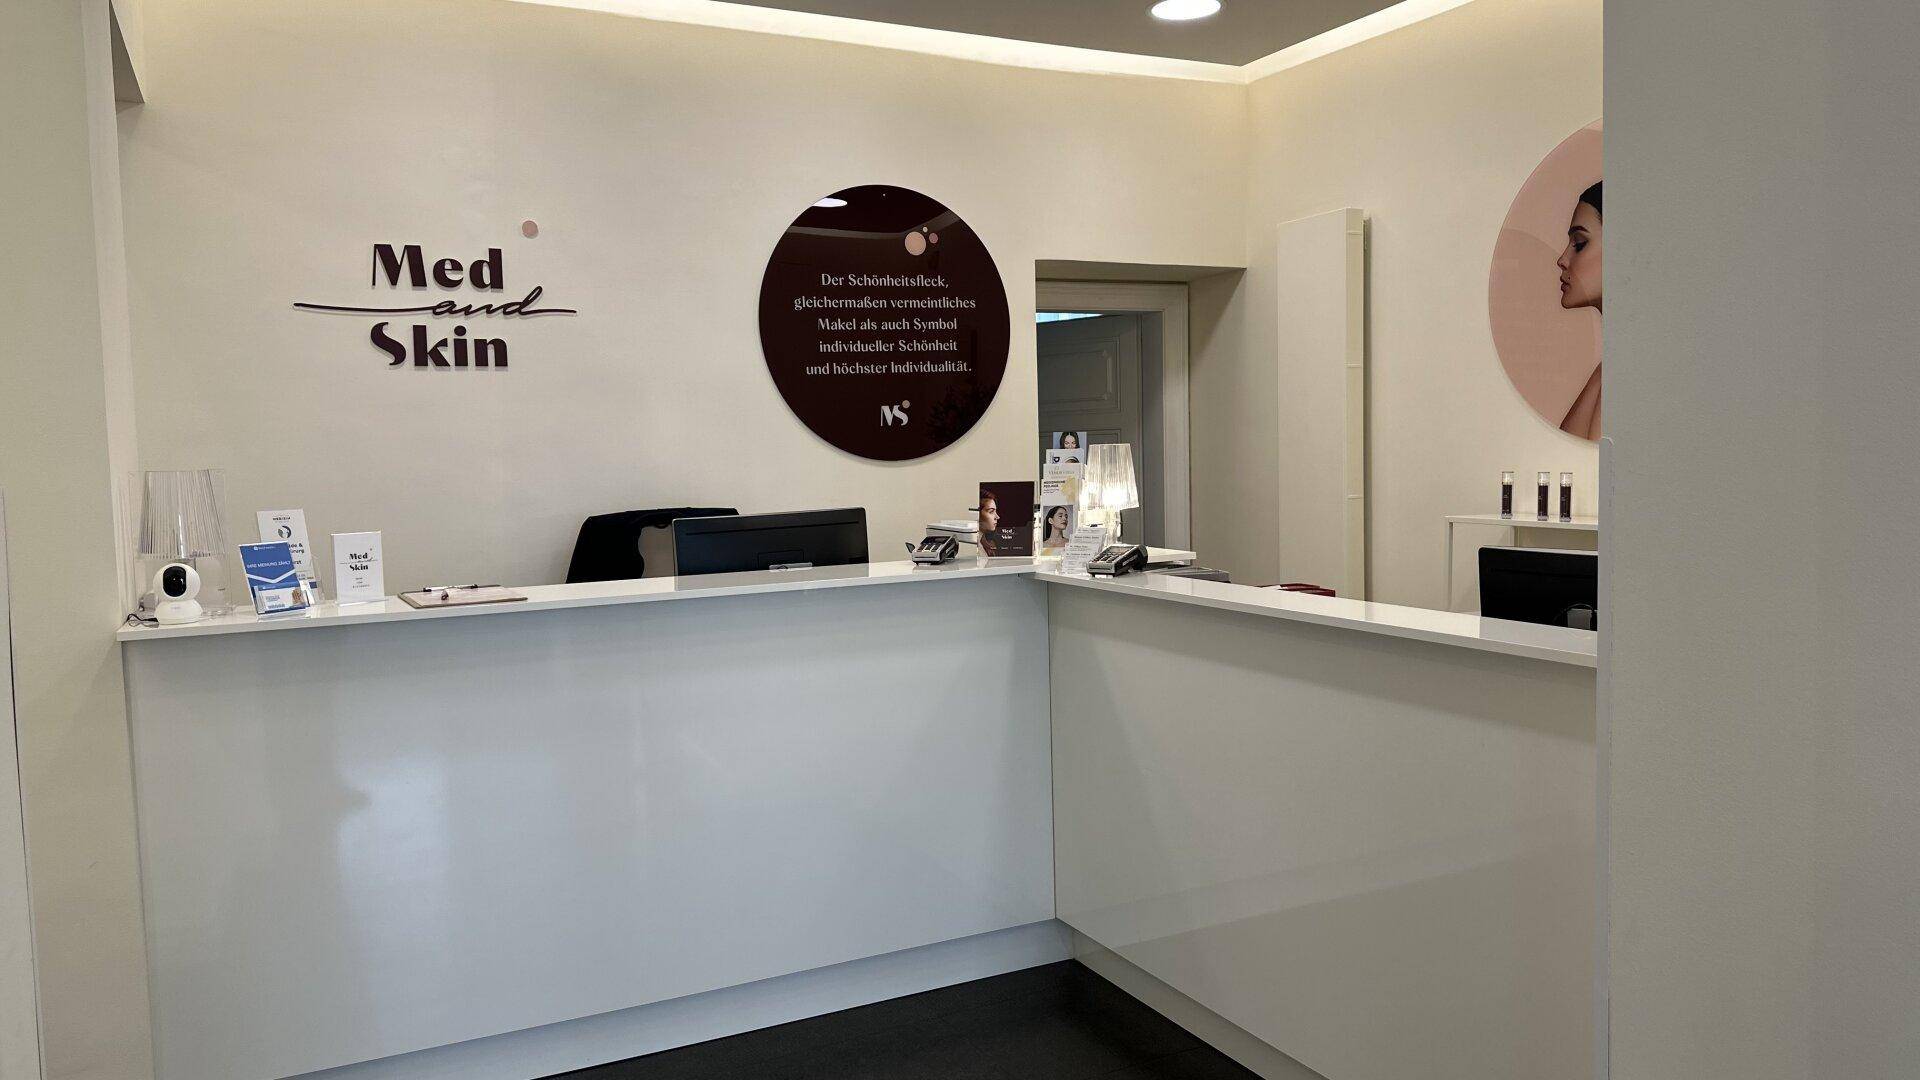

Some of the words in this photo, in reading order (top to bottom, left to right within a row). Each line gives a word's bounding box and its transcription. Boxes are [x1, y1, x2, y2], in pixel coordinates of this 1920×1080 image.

[371, 243, 504, 289] Med
[821, 273, 844, 286] Der
[848, 273, 949, 288] Schönheitsfleck,
[794, 296, 887, 311] gleichermaßen
[890, 296, 976, 309] vermeintliches
[817, 318, 856, 331] Makel
[860, 318, 877, 331] als
[881, 318, 910, 331] auch
[913, 317, 957, 333] Symbol
[370, 321, 508, 367] Skin
[819, 340, 894, 353] individueller
[898, 339, 958, 352] Schönheit
[806, 362, 830, 375] und
[833, 361, 888, 375] höchster
[891, 360, 972, 374] Individualität.
